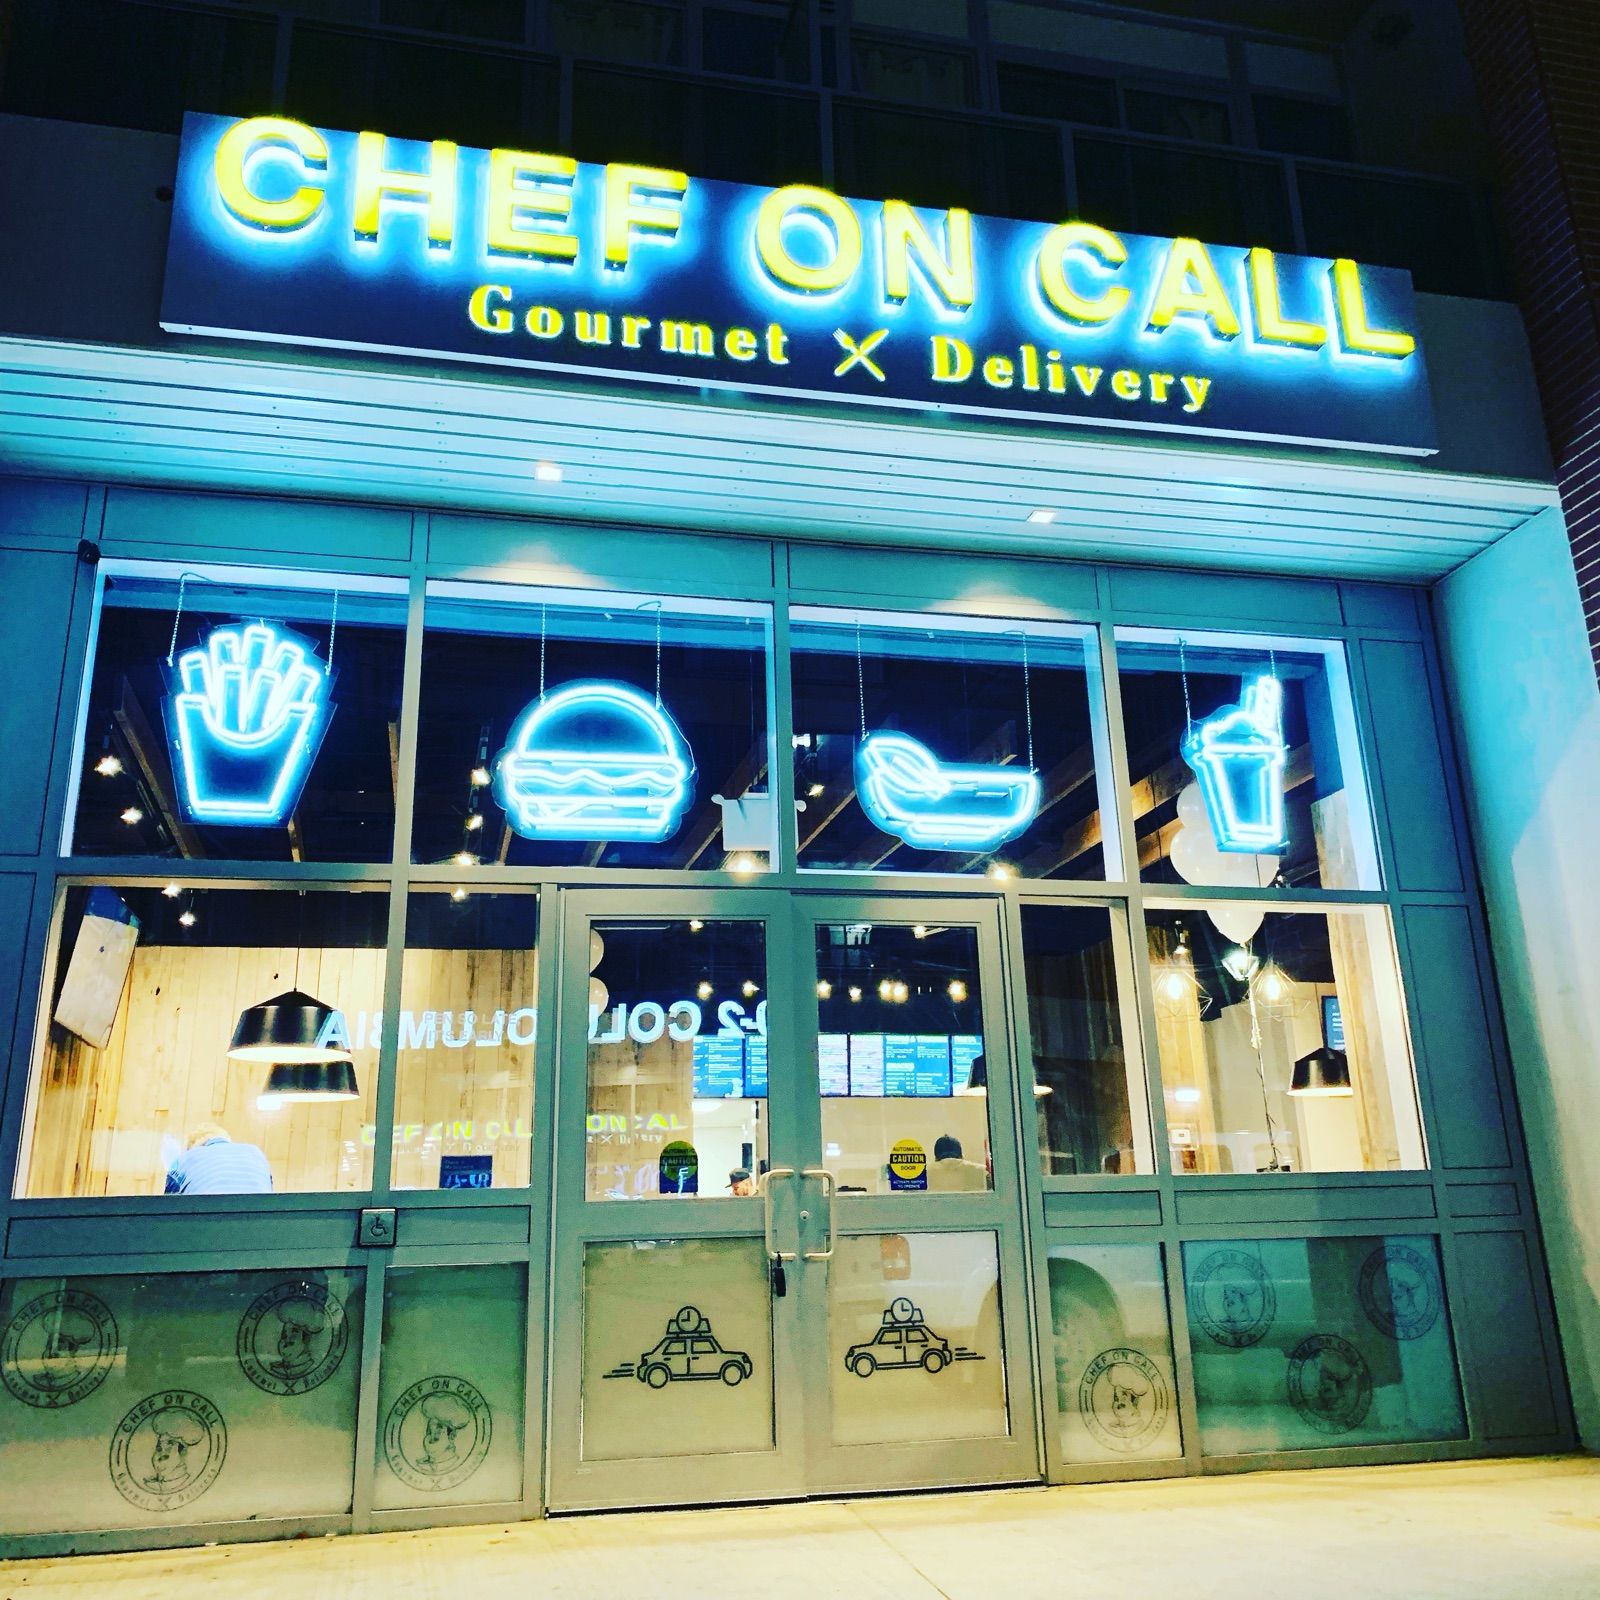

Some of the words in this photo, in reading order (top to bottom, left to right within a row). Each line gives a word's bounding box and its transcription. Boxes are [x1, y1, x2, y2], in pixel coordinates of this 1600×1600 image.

[215, 115, 689, 270] CHEF
[755, 184, 975, 308] ON
[1036, 221, 1416, 358] CALL
[468, 284, 790, 365] Gourmet
[930, 335, 1212, 413] Delivery
[892, 1154, 925, 1163] CAUTION
[244, 1289, 280, 1321] CHEF
[1085, 1355, 1107, 1385] CHEF
[1112, 1350, 1129, 1361] ON
[1133, 1355, 1159, 1382] CALL
[121, 1399, 156, 1434] CHEF
[163, 1393, 185, 1406] ON
[190, 1397, 219, 1428] CALL
[394, 1384, 425, 1418] CHEF
[431, 1379, 451, 1390] ON
[456, 1382, 484, 1412] CALL
